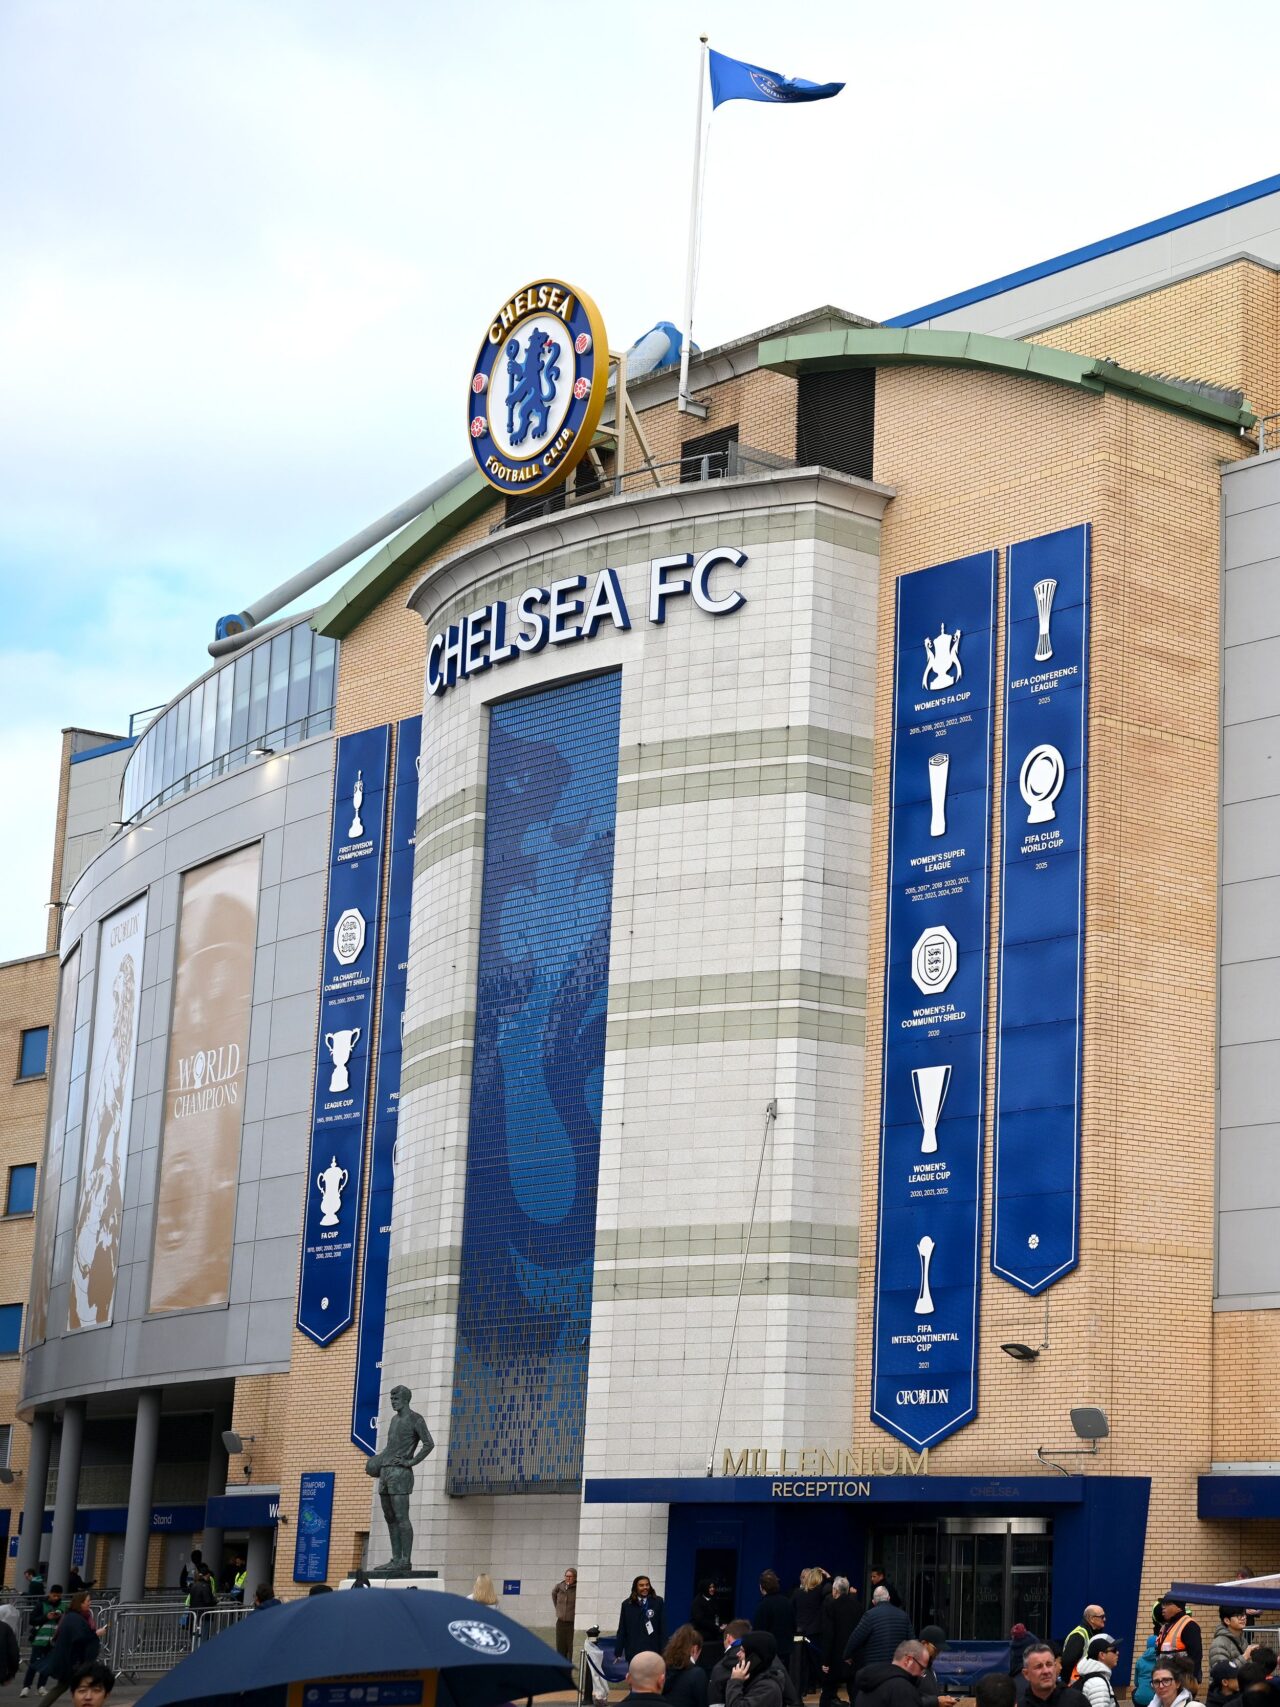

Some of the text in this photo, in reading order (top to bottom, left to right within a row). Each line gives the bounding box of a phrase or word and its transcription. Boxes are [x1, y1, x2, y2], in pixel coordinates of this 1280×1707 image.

[489, 285, 572, 344] CHELSEA
[485, 427, 571, 482] FOOTBALL CLUB
[425, 546, 748, 696] CHELSEA FC
[1011, 666, 1078, 688] UEFA CONFERENCE
[1030, 680, 1058, 693] LEAGUE
[914, 692, 971, 711] WOMEN'S FA CUP
[1024, 830, 1060, 844] FIFA CLUB
[339, 840, 374, 854] FIRST DIVISION
[1020, 839, 1064, 854] WORLD CUP
[337, 848, 374, 861] CHAMPIONSHIP
[910, 848, 966, 866] WOMEN'S SUPER
[924, 860, 952, 872] LEAGUE
[332, 975, 339, 983] FA
[339, 971, 360, 981] CHARITY
[324, 977, 370, 992] COMMUNITY SHIELD
[912, 1004, 955, 1017] WOMEN'S FA
[901, 1011, 966, 1028] COMMUNITY SHIELD
[177, 1042, 240, 1092] WORLD
[174, 1081, 239, 1119] CHAMPIONS
[324, 1099, 354, 1110] LEAGUE CUP
[913, 1162, 946, 1173] WOMEN'S
[908, 1171, 951, 1183] LEAGUE CUP
[327, 1231, 339, 1239] CUP
[917, 1324, 932, 1333] FIFA
[891, 1333, 959, 1344] INTERCONTINENTAL
[916, 1343, 932, 1352] CUP
[722, 1447, 931, 1476] MILLENNIUM
[771, 1481, 871, 1497] RECEPTION
[153, 1513, 173, 1525] Stand
